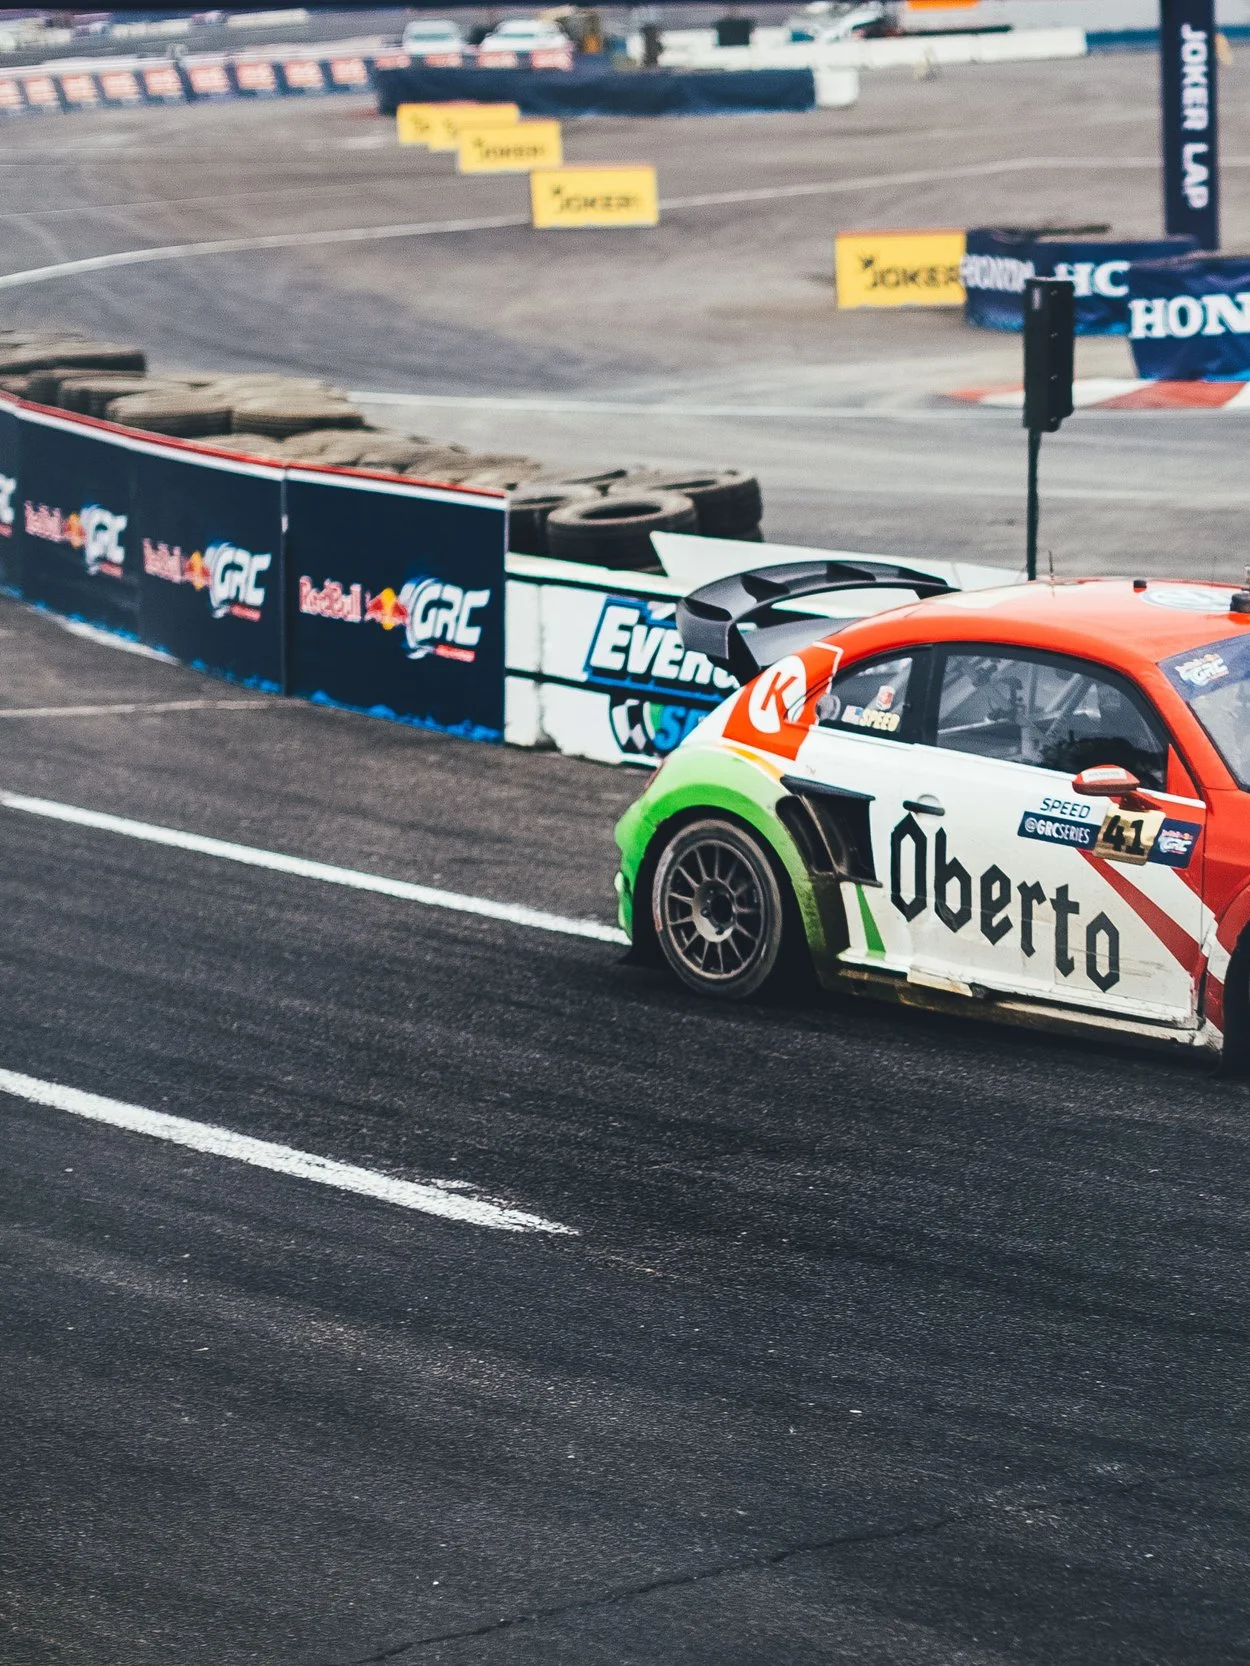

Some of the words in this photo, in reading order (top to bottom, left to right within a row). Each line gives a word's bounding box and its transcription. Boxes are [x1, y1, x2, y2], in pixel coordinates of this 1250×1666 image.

[1180, 23, 1209, 130] JOKER
[1181, 142, 1210, 209] LAP
[412, 582, 491, 646] GRC
[1024, 815, 1091, 845] @GRCSERIES
[1039, 797, 1091, 819] SPEED
[1102, 814, 1145, 856] 41
[890, 811, 1121, 994] Oberto
